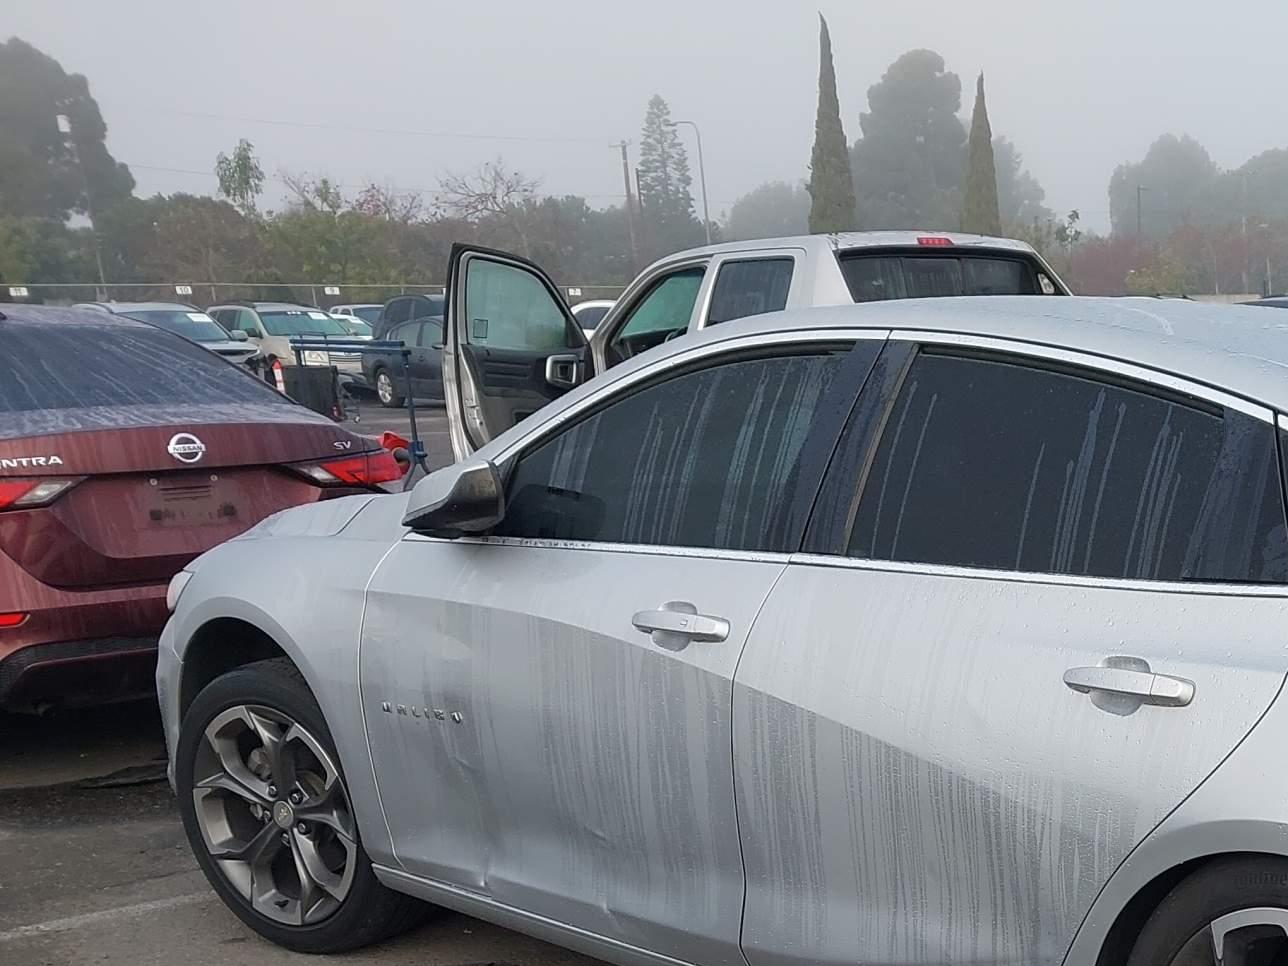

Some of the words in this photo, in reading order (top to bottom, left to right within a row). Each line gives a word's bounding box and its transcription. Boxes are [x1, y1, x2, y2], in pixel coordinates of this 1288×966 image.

[173, 444, 203, 452] NISSAN
[333, 440, 351, 450] SV
[0, 455, 63, 469] NTRA
